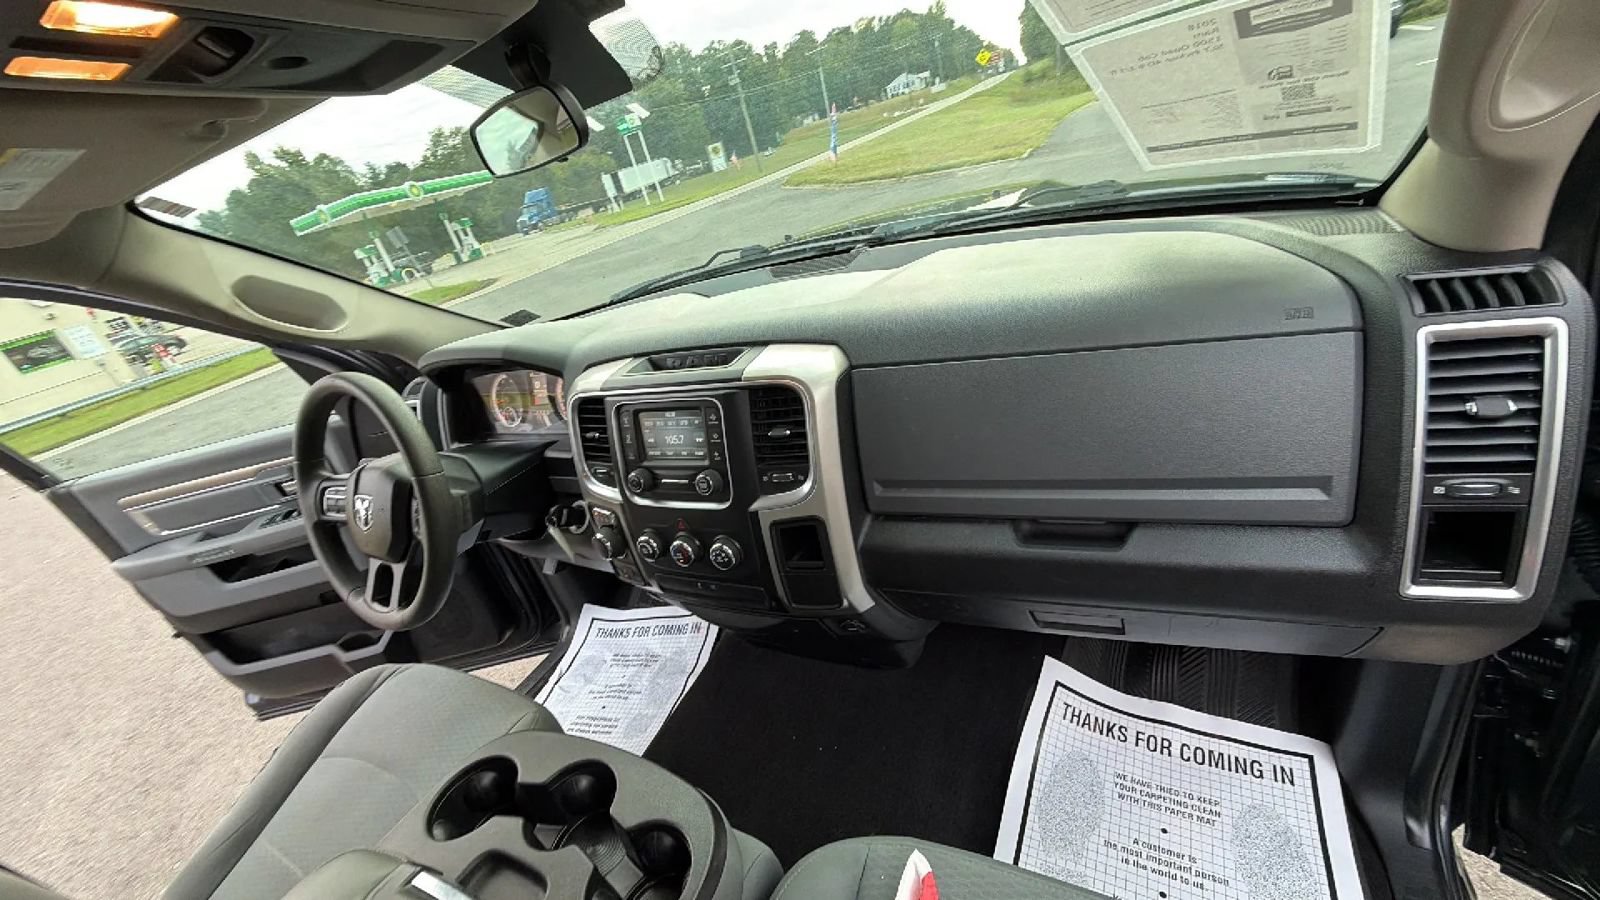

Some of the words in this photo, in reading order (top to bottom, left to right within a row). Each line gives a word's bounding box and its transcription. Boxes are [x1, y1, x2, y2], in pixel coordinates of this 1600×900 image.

[595, 627, 631, 639] THANKS
[632, 625, 650, 638] FOR
[652, 623, 688, 637] COMING
[690, 621, 702, 634] IN
[1062, 702, 1128, 743] THANKS
[1135, 731, 1172, 758] FOR
[1180, 743, 1264, 780] COMING
[1272, 763, 1295, 787] IN
[1114, 781, 1137, 794] YOUR
[1139, 789, 1188, 809] CARPETING
[1191, 803, 1221, 818] CLEAN
[1115, 771, 1128, 781] WE
[1131, 776, 1152, 788] HAVE
[1155, 783, 1180, 797] TRIED
[1183, 791, 1194, 800] TO
[1197, 796, 1220, 807] KEEP
[1117, 792, 1139, 804] WITH
[1142, 800, 1162, 811] THIS
[1164, 806, 1194, 820] PAPER
[1196, 815, 1217, 827] MAT
[1104, 839, 1118, 850] the
[1120, 845, 1143, 858] most
[1146, 853, 1193, 875] important
[1194, 869, 1230, 887] person
[1133, 838, 1139, 846] A
[1141, 840, 1186, 860] customer
[1188, 854, 1198, 864] is
[1133, 859, 1148, 871] the
[1150, 867, 1177, 881] world
[1180, 875, 1190, 885] to
